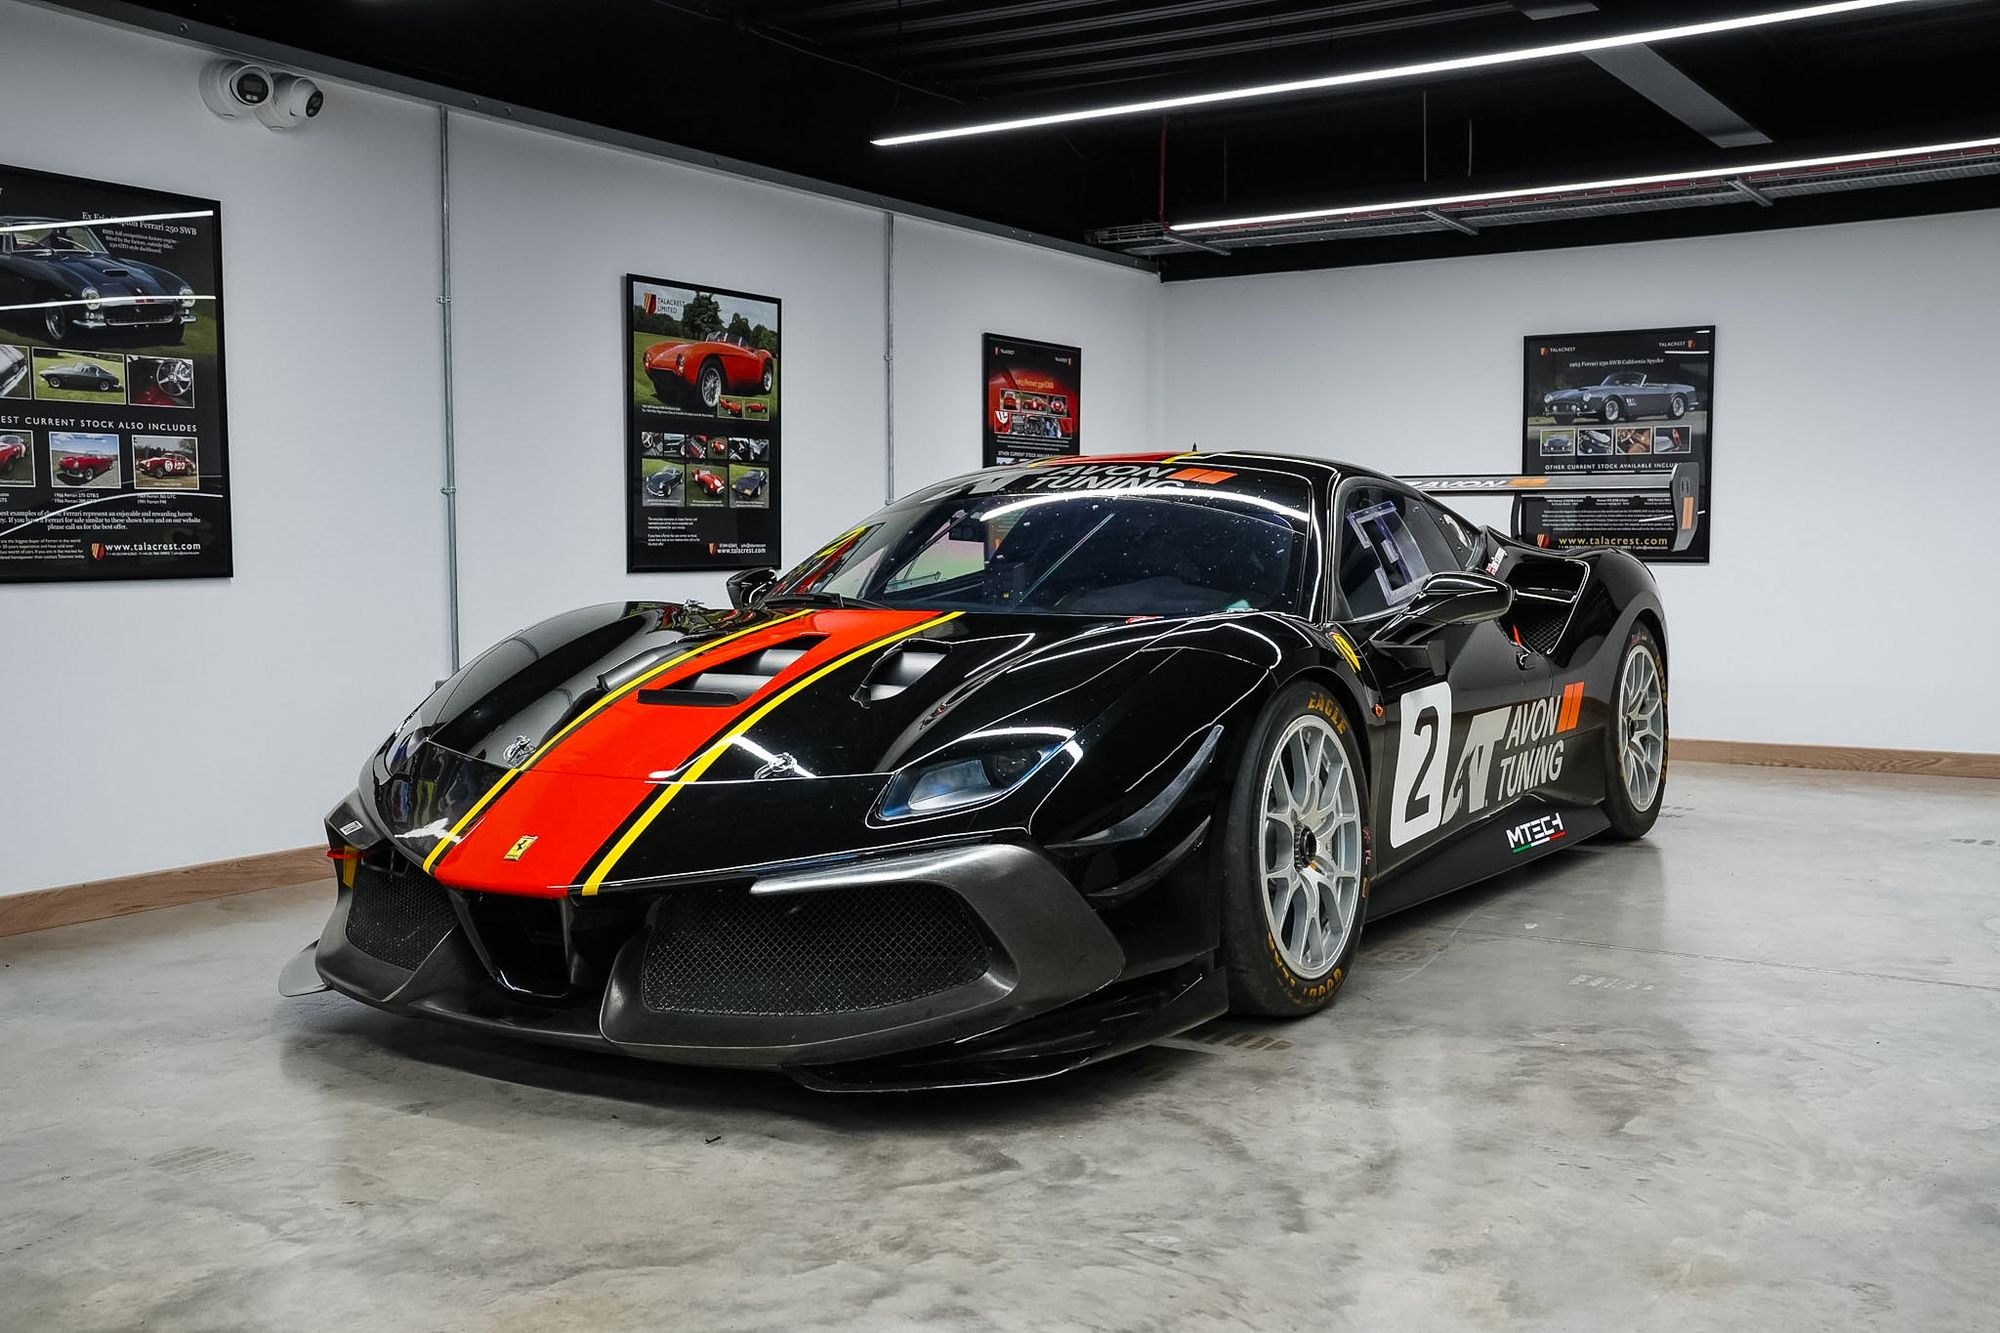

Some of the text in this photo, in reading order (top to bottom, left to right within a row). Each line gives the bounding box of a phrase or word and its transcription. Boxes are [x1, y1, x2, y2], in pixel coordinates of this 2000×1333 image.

[82, 211, 92, 220] Ex
[140, 221, 164, 232] Ferrari
[165, 225, 179, 234] 250
[180, 226, 198, 236] SWB
[24, 416, 75, 427] CURRENT
[80, 419, 114, 429] STOCK
[118, 421, 144, 430] ALSO
[148, 423, 197, 432] INCLUDES
[1048, 464, 1177, 477] AVON
[104, 541, 201, 551] www.talacrest.com
[1558, 535, 1668, 545] www.talacrest.com
[1307, 691, 1347, 735] EAGLE
[1505, 695, 1562, 750] AVON
[1404, 705, 1440, 824] 2
[1498, 739, 1565, 802] TUNING
[1506, 812, 1564, 848] MTECH
